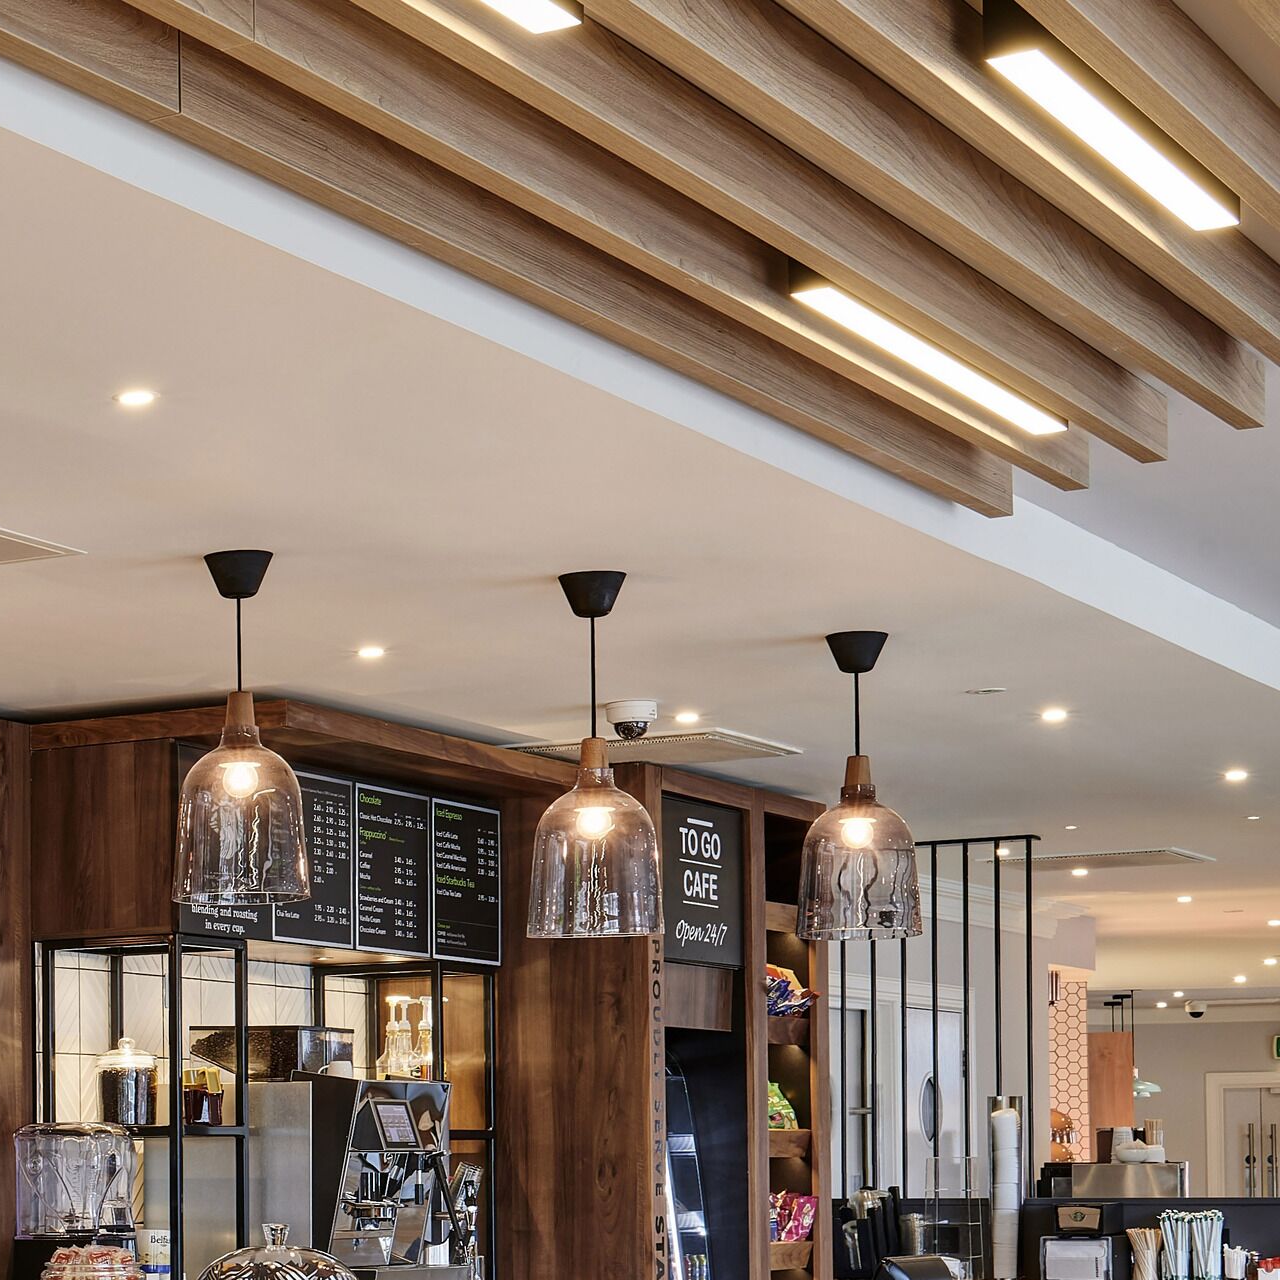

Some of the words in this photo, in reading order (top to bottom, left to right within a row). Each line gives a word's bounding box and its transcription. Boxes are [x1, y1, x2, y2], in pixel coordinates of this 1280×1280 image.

[359, 793, 382, 805] Chocolate
[679, 827, 698, 855] TO
[701, 832, 721, 860] GO
[683, 869, 718, 901] CAFE
[220, 907, 231, 917] and
[233, 910, 258, 923] roasting
[205, 919, 212, 930] in
[213, 923, 230, 933] every
[232, 924, 245, 934] cup.
[676, 920, 704, 947] Open
[704, 923, 728, 947] 24/7
